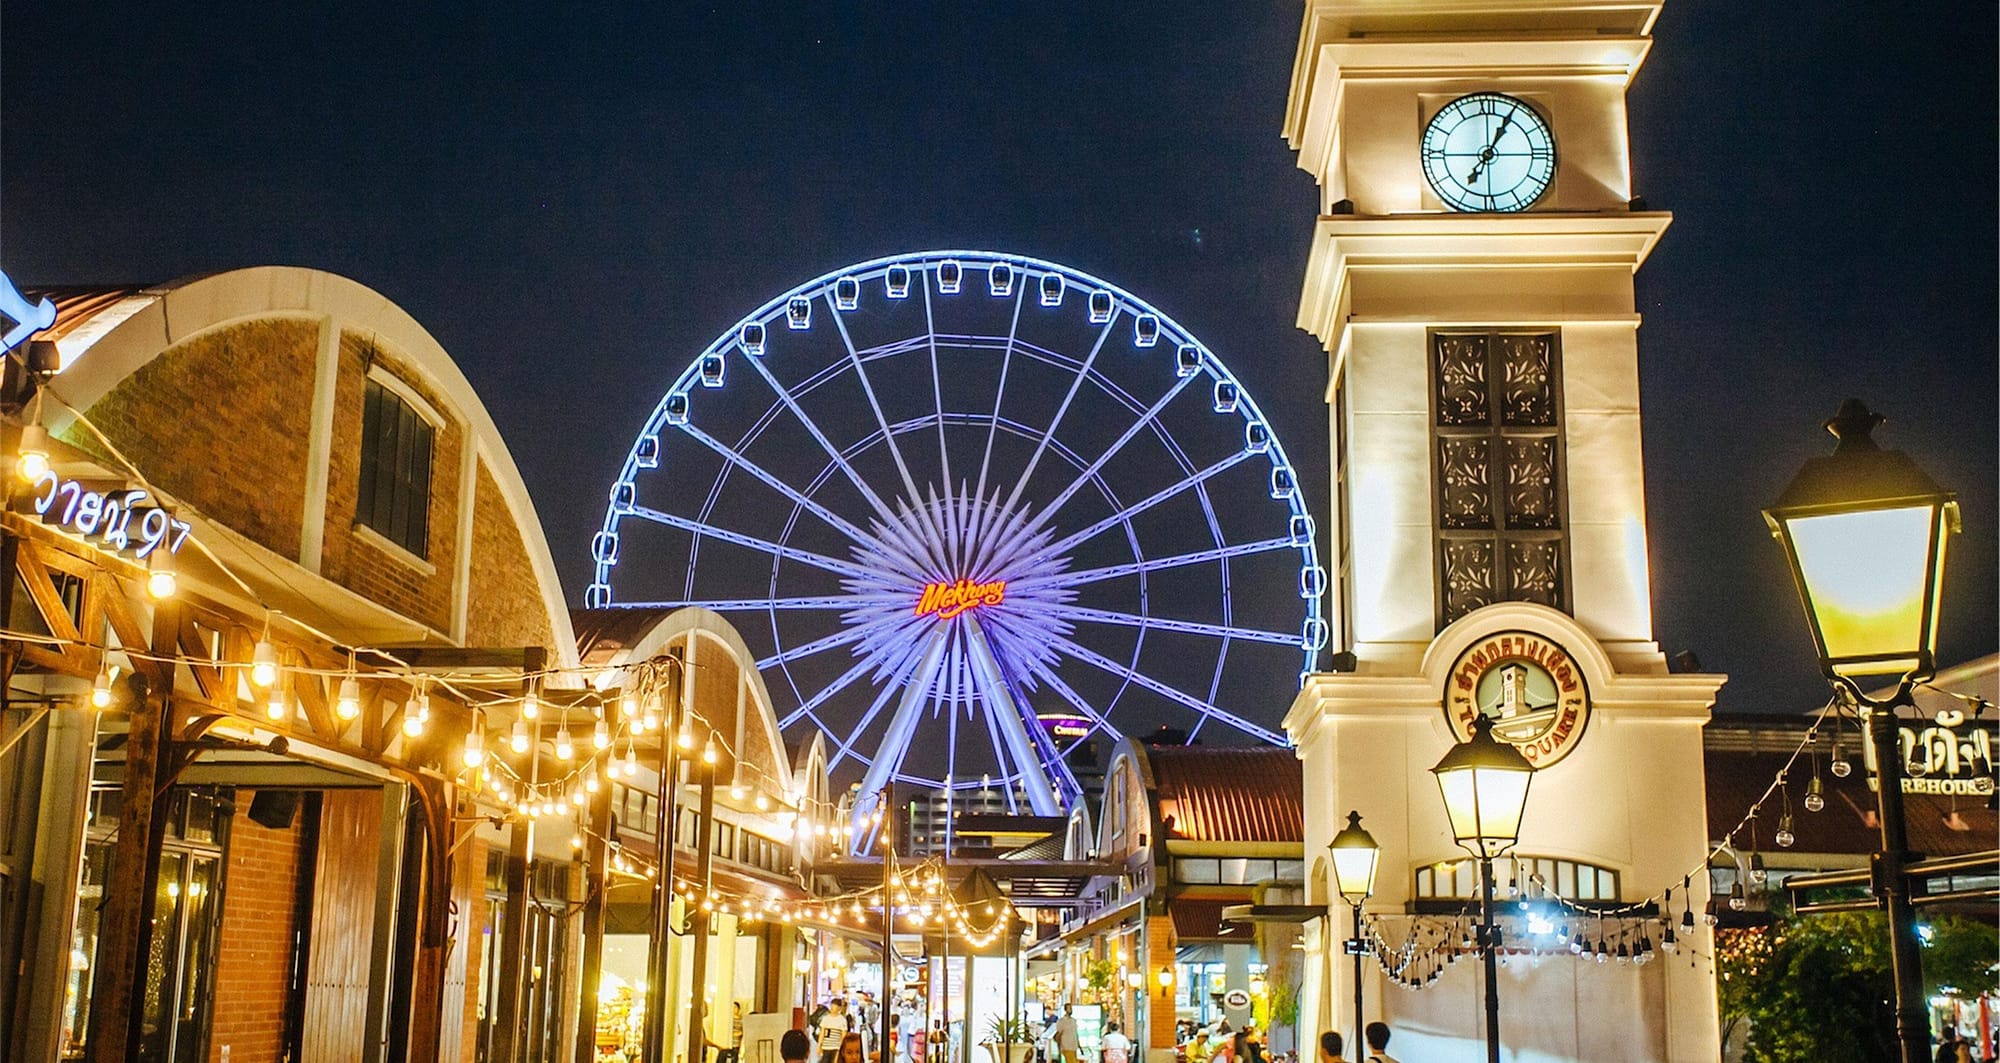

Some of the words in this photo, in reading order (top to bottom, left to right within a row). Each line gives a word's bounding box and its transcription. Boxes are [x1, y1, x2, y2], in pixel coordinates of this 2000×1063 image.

[34, 470, 147, 550] วายน์
[136, 508, 191, 559] 97
[915, 579, 1006, 619] Mekhong
[1514, 706, 1578, 761] QUARE
[1866, 777, 1994, 795] REHOUS
